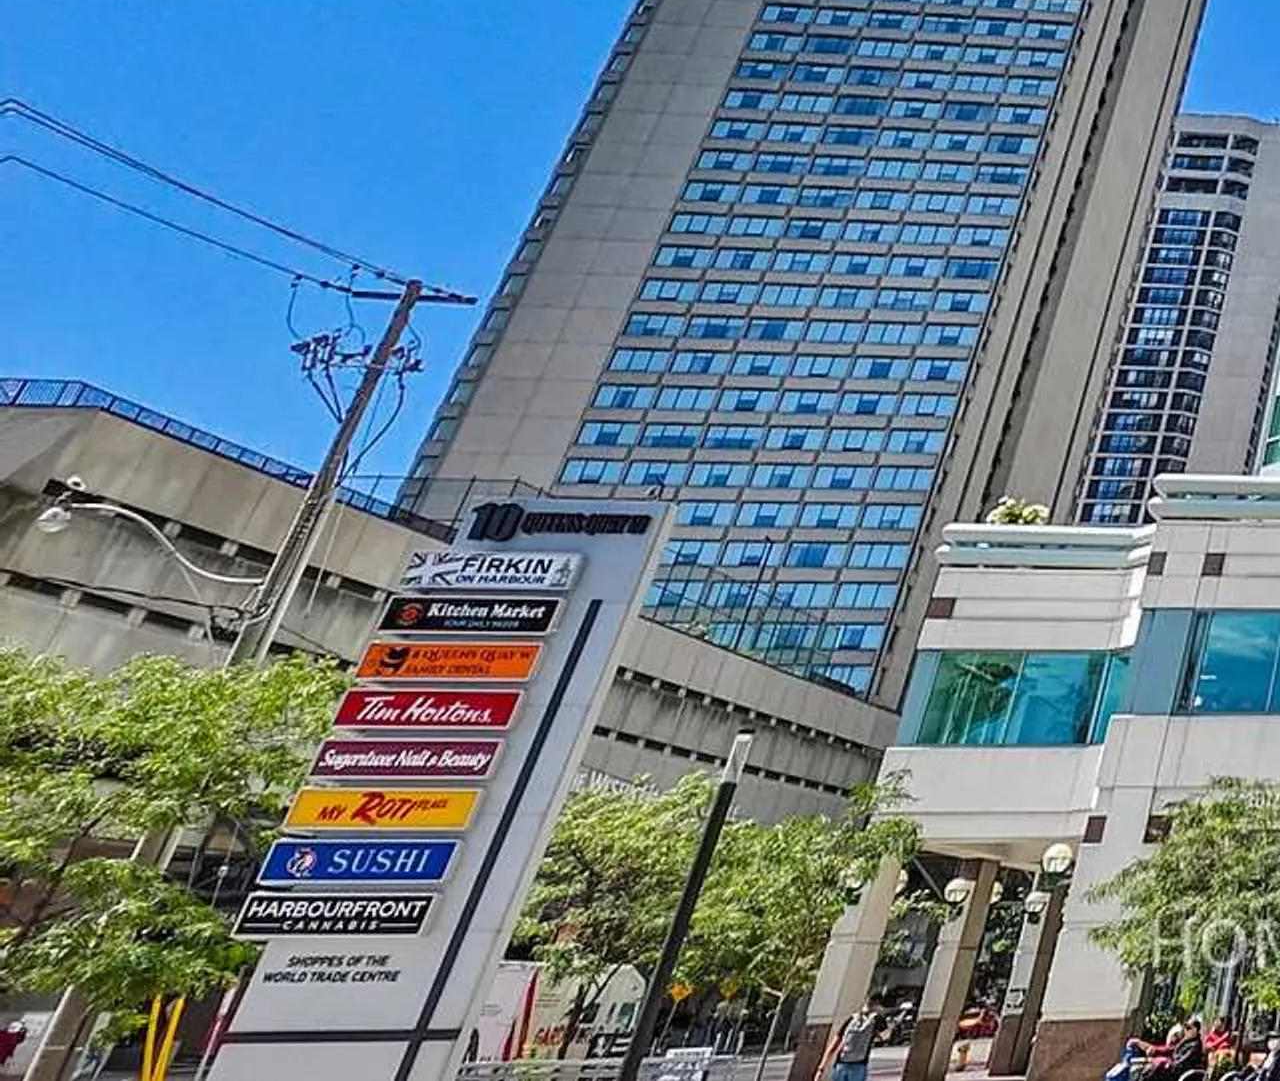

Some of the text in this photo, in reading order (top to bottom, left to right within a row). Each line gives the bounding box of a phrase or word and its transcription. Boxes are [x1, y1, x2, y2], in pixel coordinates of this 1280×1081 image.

[468, 502, 526, 542] 10
[460, 557, 554, 575] FIRKIN
[455, 574, 547, 585] ON HARBOUR
[427, 602, 546, 619] Kitchen Market
[356, 695, 402, 721] Tim
[394, 749, 432, 767] Nail
[437, 749, 492, 770] Beauty
[316, 805, 348, 821] MY
[327, 848, 433, 873] SUSHI
[246, 900, 428, 919] HARBOURFRONT
[281, 919, 381, 931] CANNABIS
[286, 954, 391, 968] SHOPPES OF THE
[262, 970, 401, 984] WORLD TRADE CENTRE
